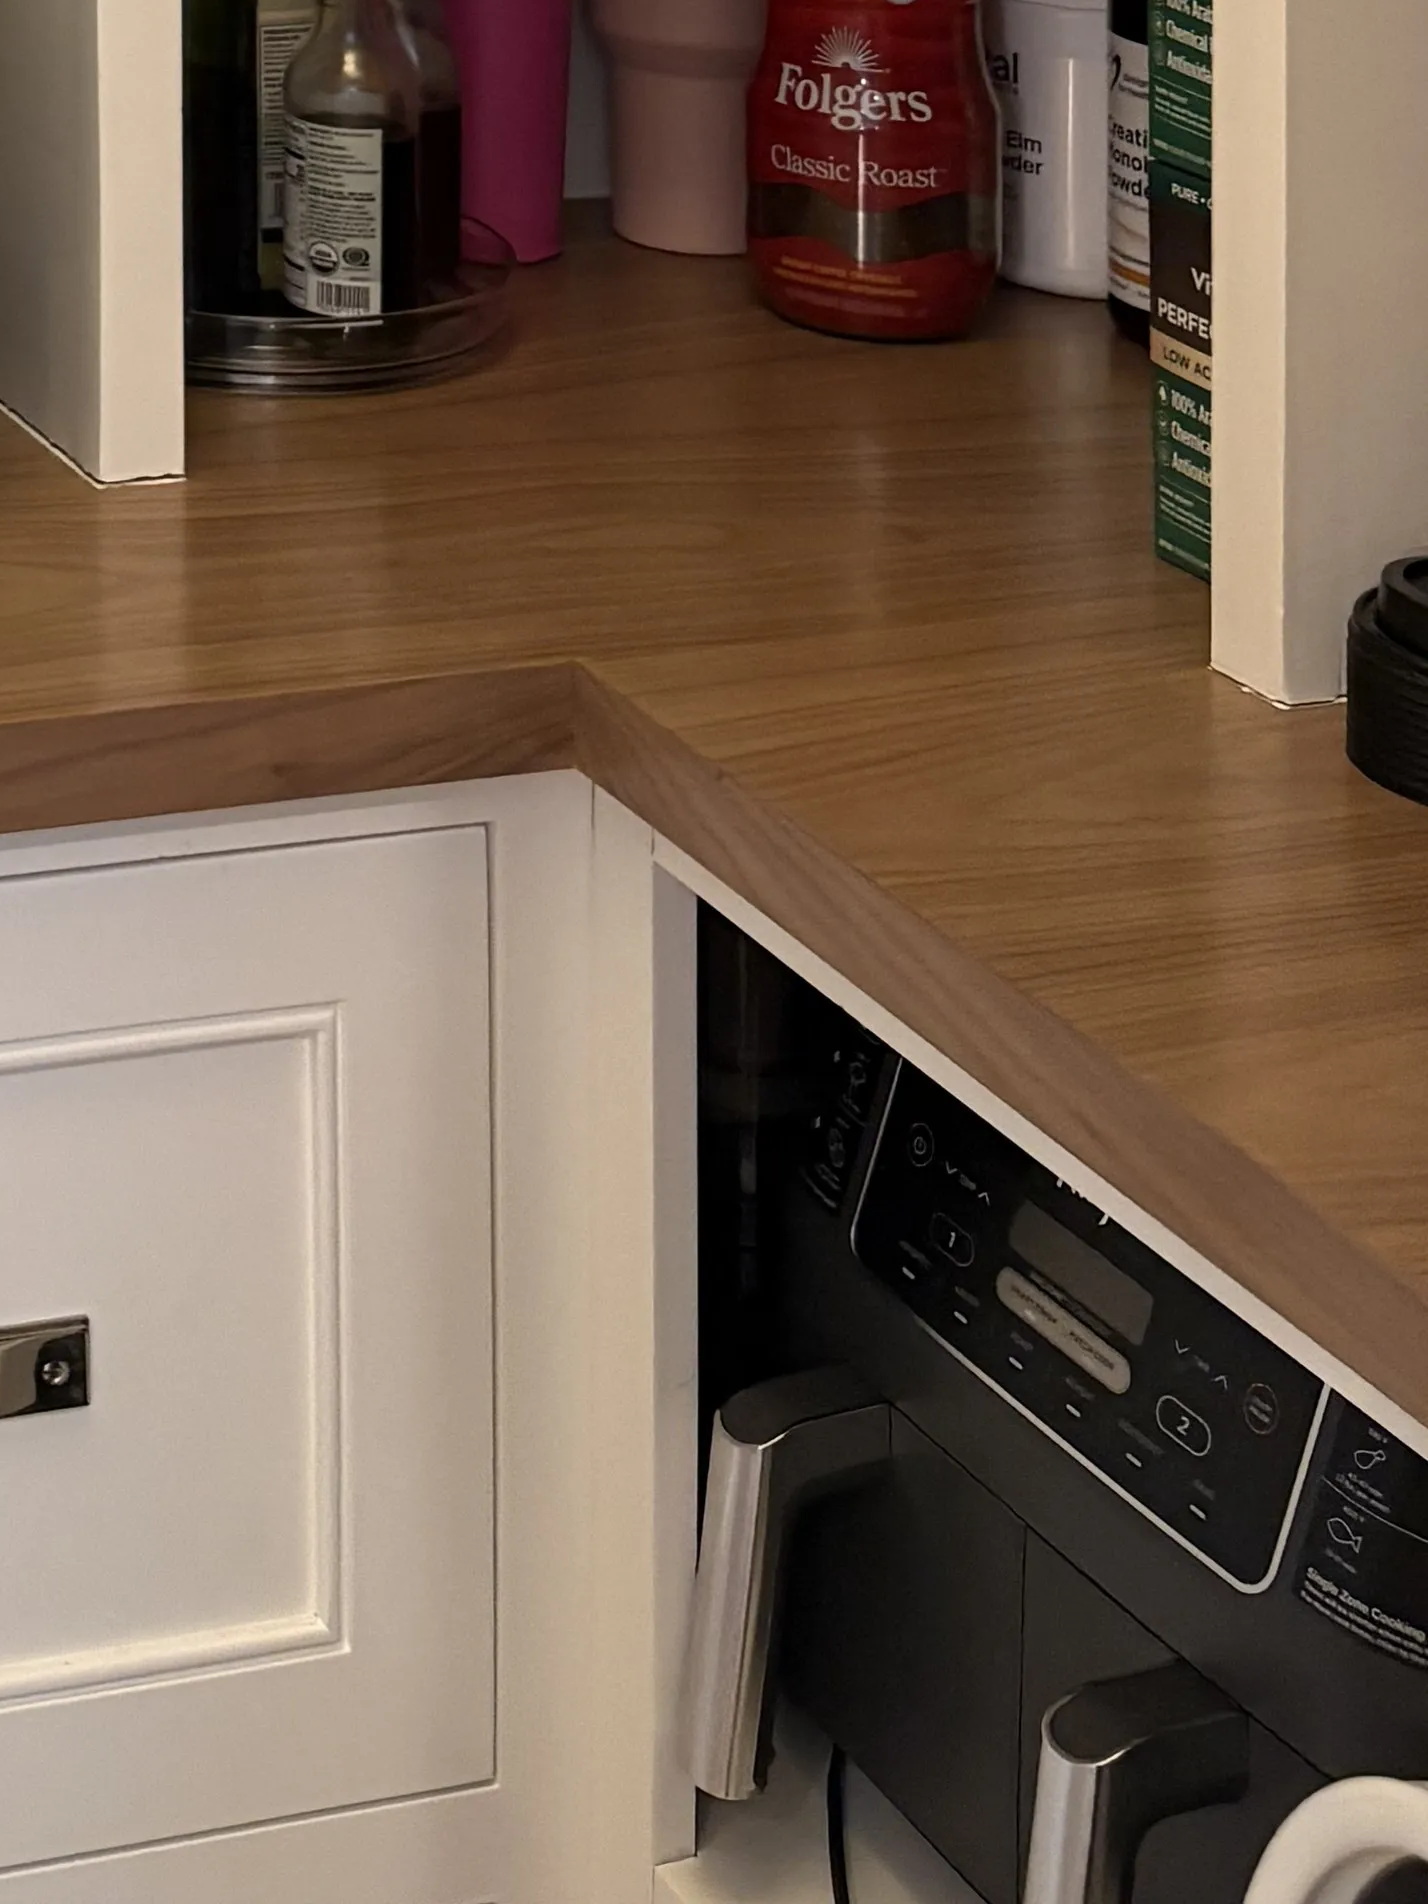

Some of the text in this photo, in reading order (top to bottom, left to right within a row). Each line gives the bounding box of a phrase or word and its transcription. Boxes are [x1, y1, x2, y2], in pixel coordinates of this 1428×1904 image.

[774, 61, 933, 132] Folgers
[1006, 129, 1043, 154] Elm
[770, 143, 938, 189] Classic Roast
[1161, 345, 1190, 373] LOW
[1176, 1416, 1190, 1436] 2
[1339, 1588, 1427, 1644] Zone Cooking
